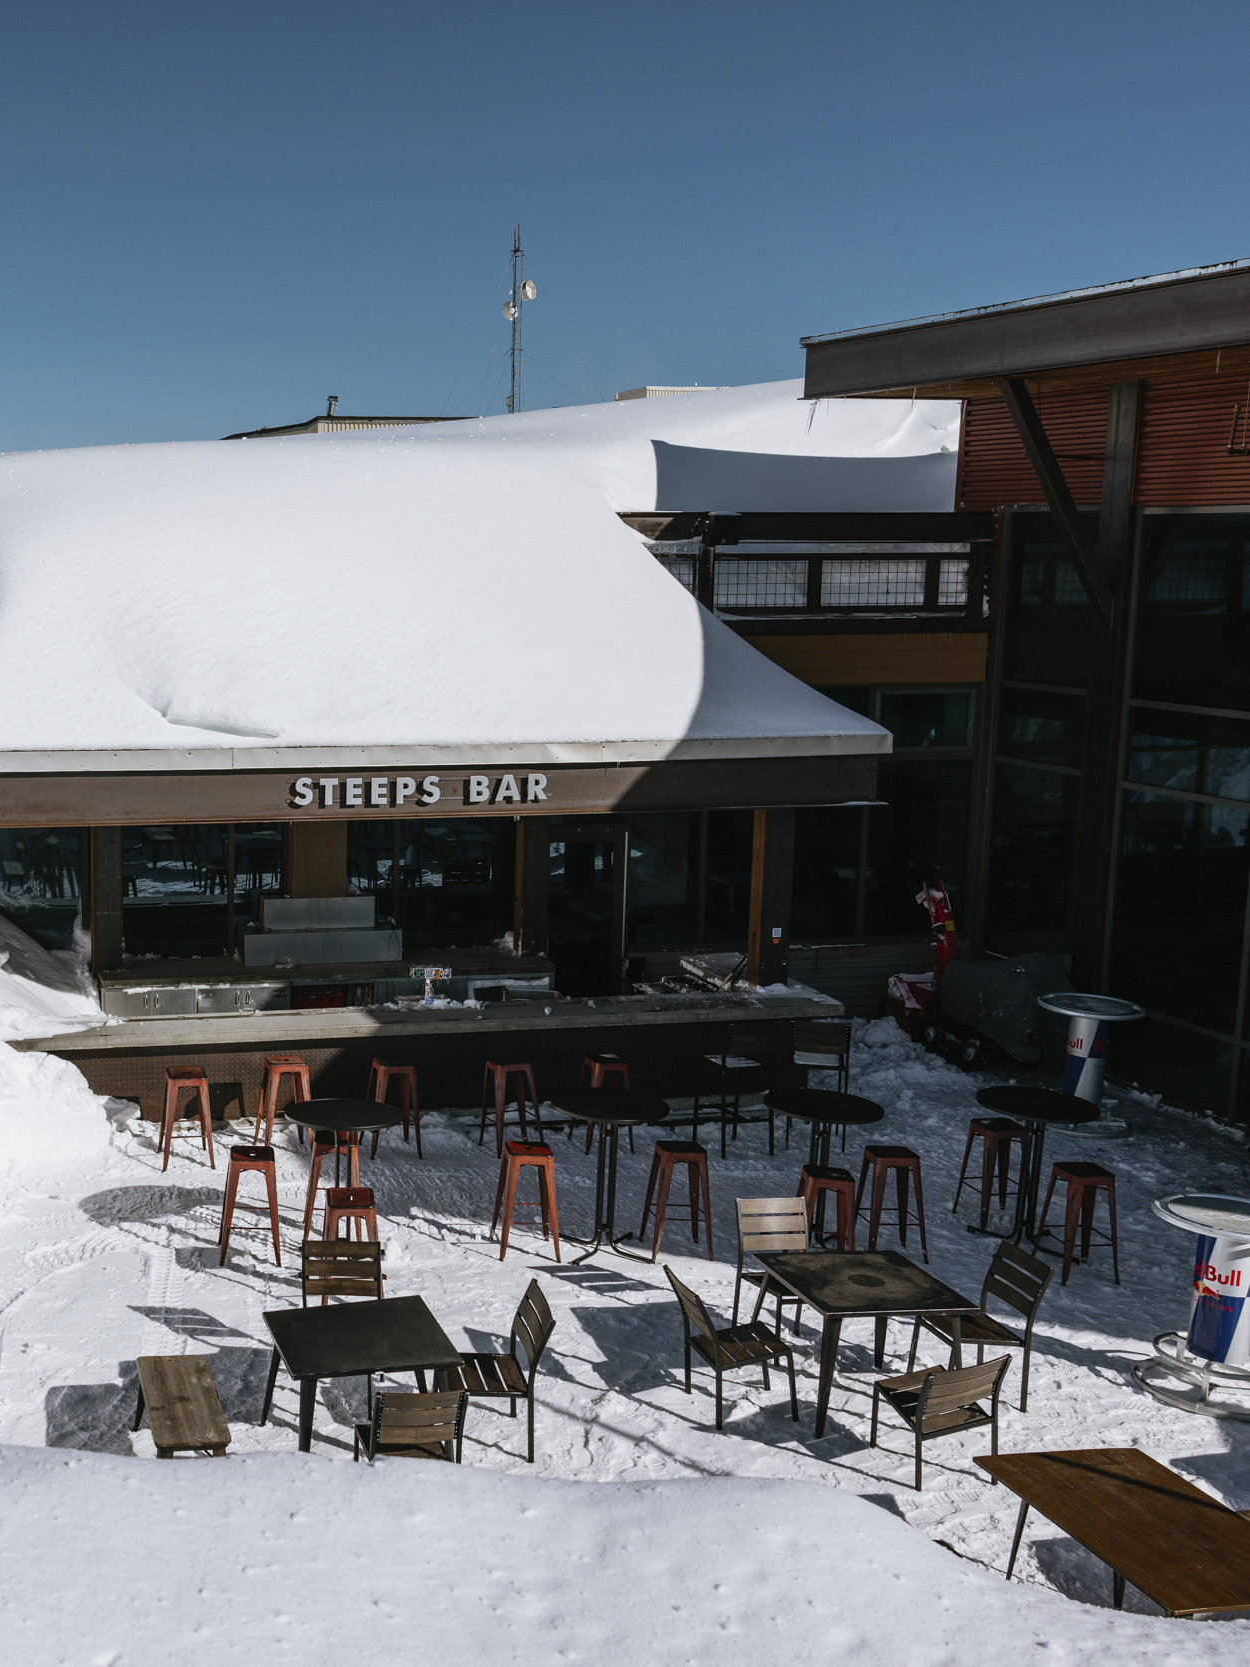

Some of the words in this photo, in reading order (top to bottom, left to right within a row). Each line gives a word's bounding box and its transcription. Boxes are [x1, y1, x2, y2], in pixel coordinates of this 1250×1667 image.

[293, 775, 441, 806] STEEPS
[469, 773, 548, 804] BAR
[1205, 1264, 1241, 1286] Bull
[1204, 1300, 1233, 1312] DRINK
